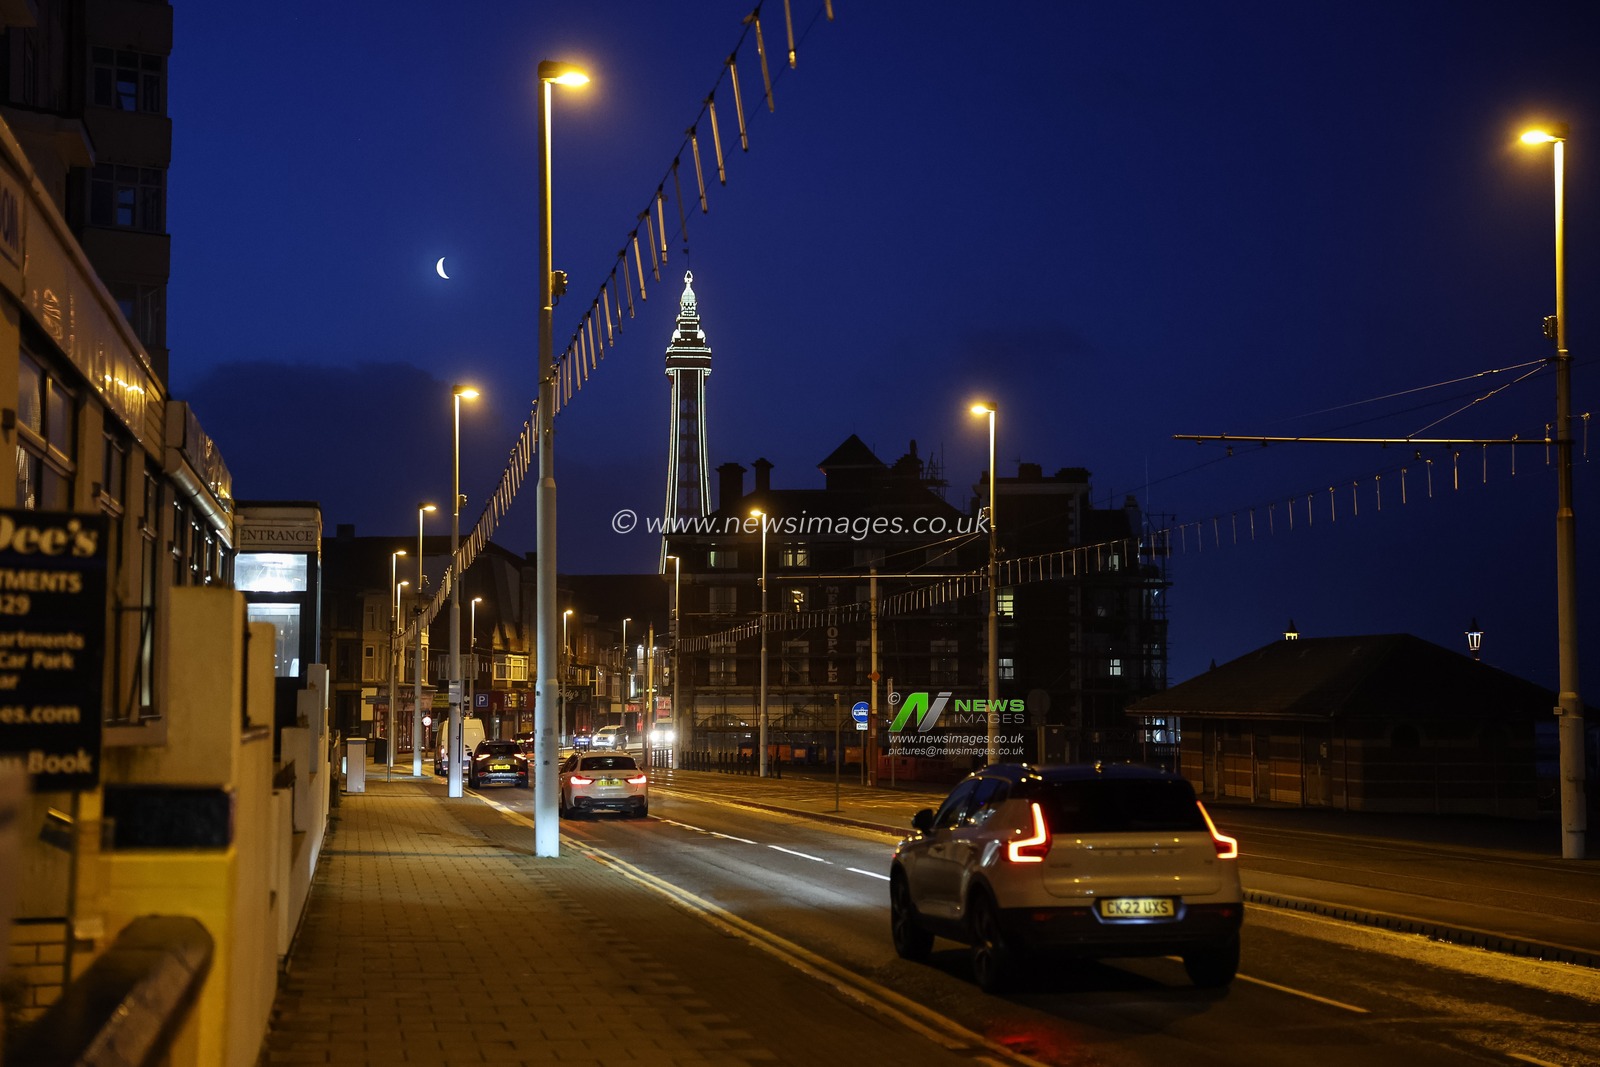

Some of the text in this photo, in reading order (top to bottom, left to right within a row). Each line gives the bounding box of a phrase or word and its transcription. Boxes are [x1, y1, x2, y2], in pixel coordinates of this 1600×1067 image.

[240, 529, 314, 542] ENTRANCE
[32, 651, 75, 670] Park
[478, 695, 486, 705] P
[27, 749, 93, 774] Book
[1107, 901, 1169, 914] CK22 UXS
